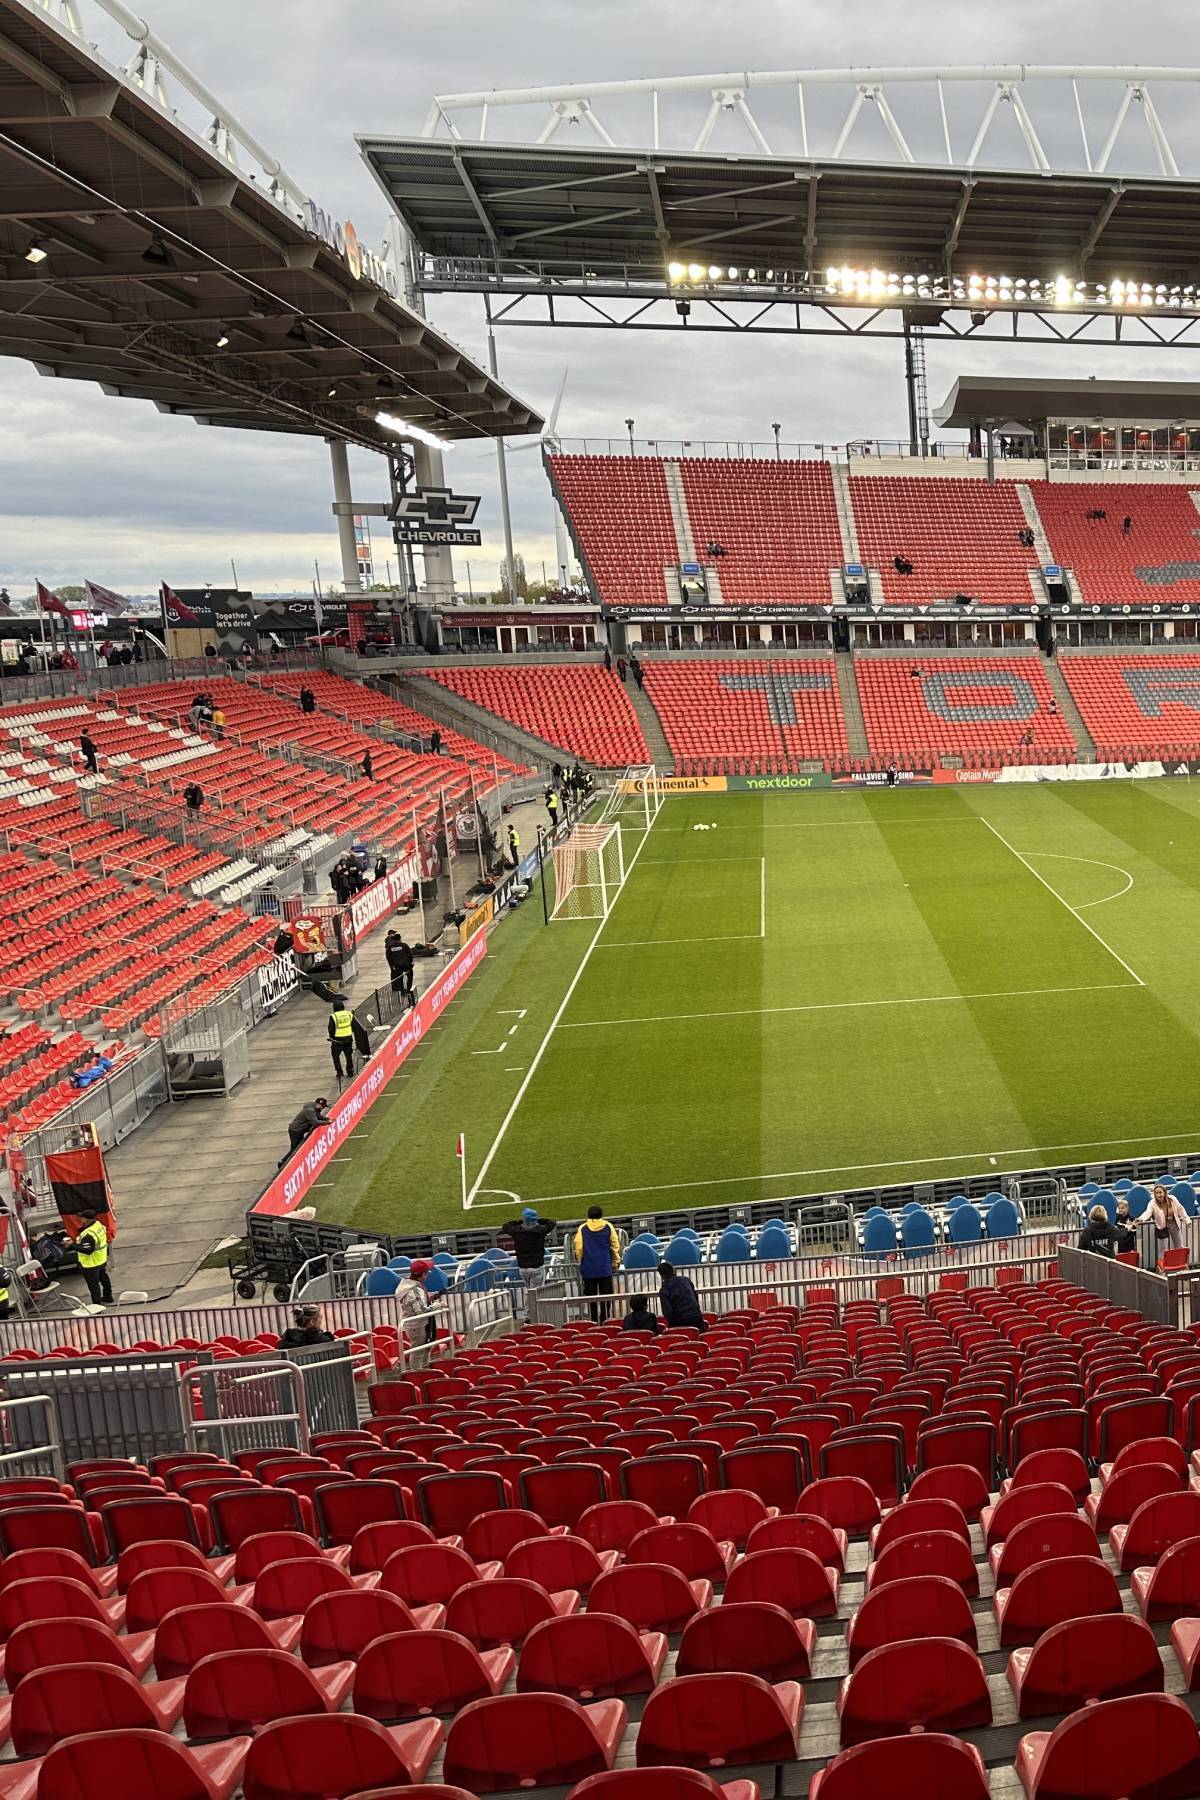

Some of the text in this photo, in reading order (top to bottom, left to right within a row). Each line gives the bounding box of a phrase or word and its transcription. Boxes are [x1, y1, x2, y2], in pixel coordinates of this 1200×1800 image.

[397, 531, 479, 542] CHEVROLET
[215, 612, 247, 621] Together
[216, 620, 250, 628] let's drive
[747, 775, 813, 789] nextdoor
[852, 773, 888, 781] FALLSVIEW
[634, 778, 699, 792] Continental
[283, 1063, 385, 1204] SIXTY YEARS OF KEEPING IT FRESH
